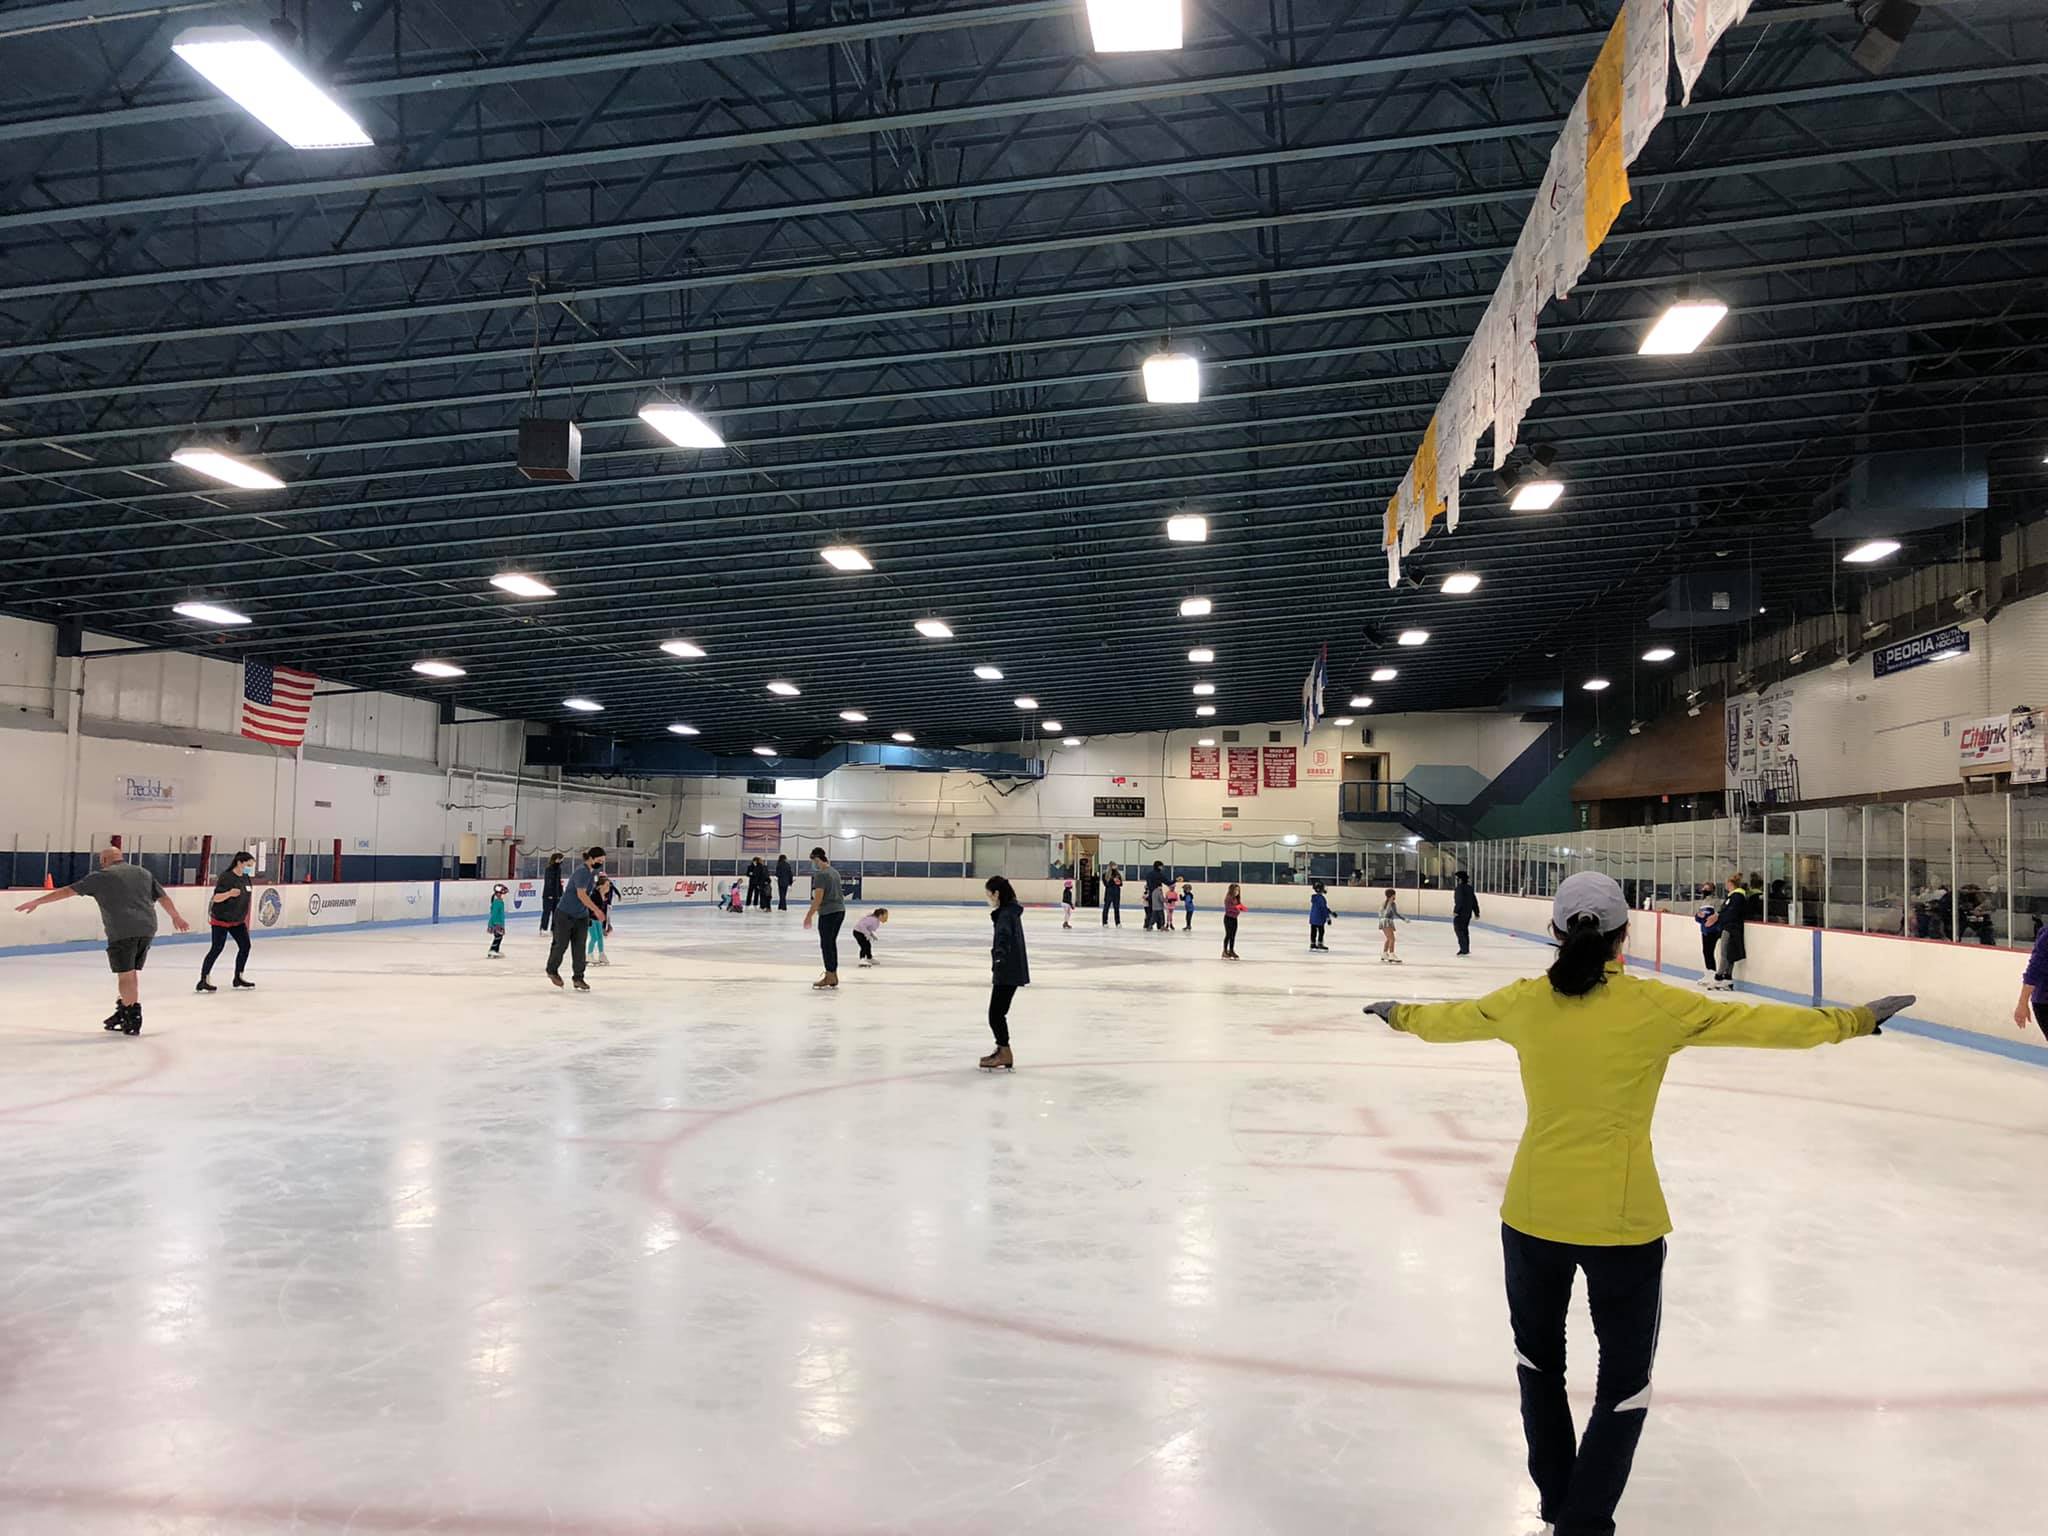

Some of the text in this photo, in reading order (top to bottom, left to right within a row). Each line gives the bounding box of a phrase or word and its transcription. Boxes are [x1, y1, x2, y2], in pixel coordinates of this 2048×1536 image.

[1936, 628, 1961, 641] YOUTH
[1936, 633, 1967, 649] HOCKEY
[1886, 637, 1935, 664] PEORIA
[322, 899, 357, 909] WARRIOR
